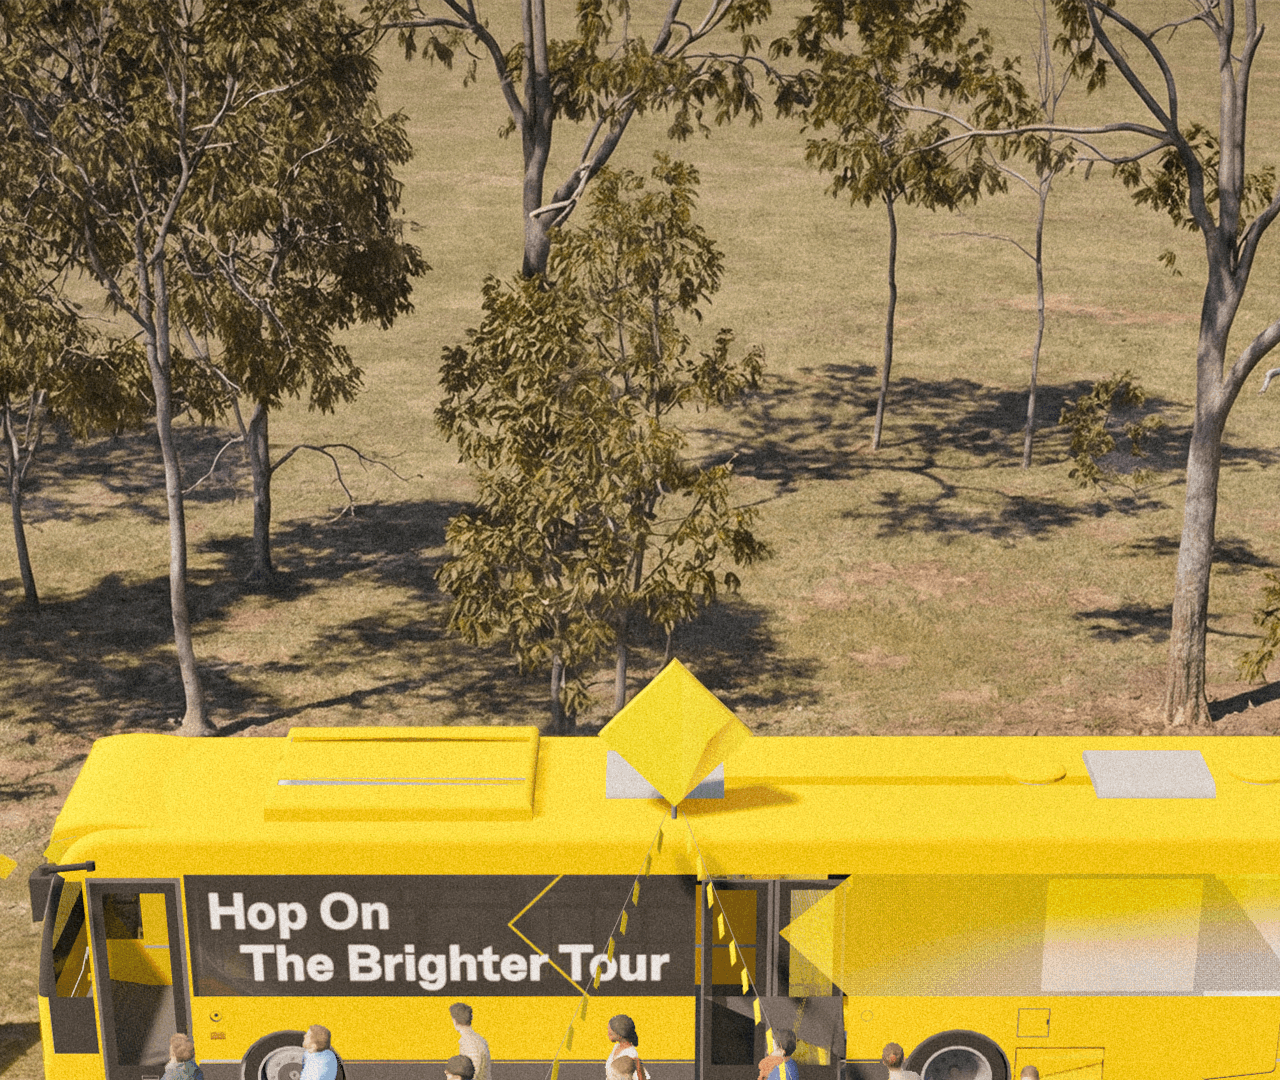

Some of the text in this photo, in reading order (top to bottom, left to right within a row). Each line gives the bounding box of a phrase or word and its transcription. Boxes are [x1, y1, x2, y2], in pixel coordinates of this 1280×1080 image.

[208, 891, 390, 940] Hop On
[239, 943, 670, 991] The Brighter Tour
